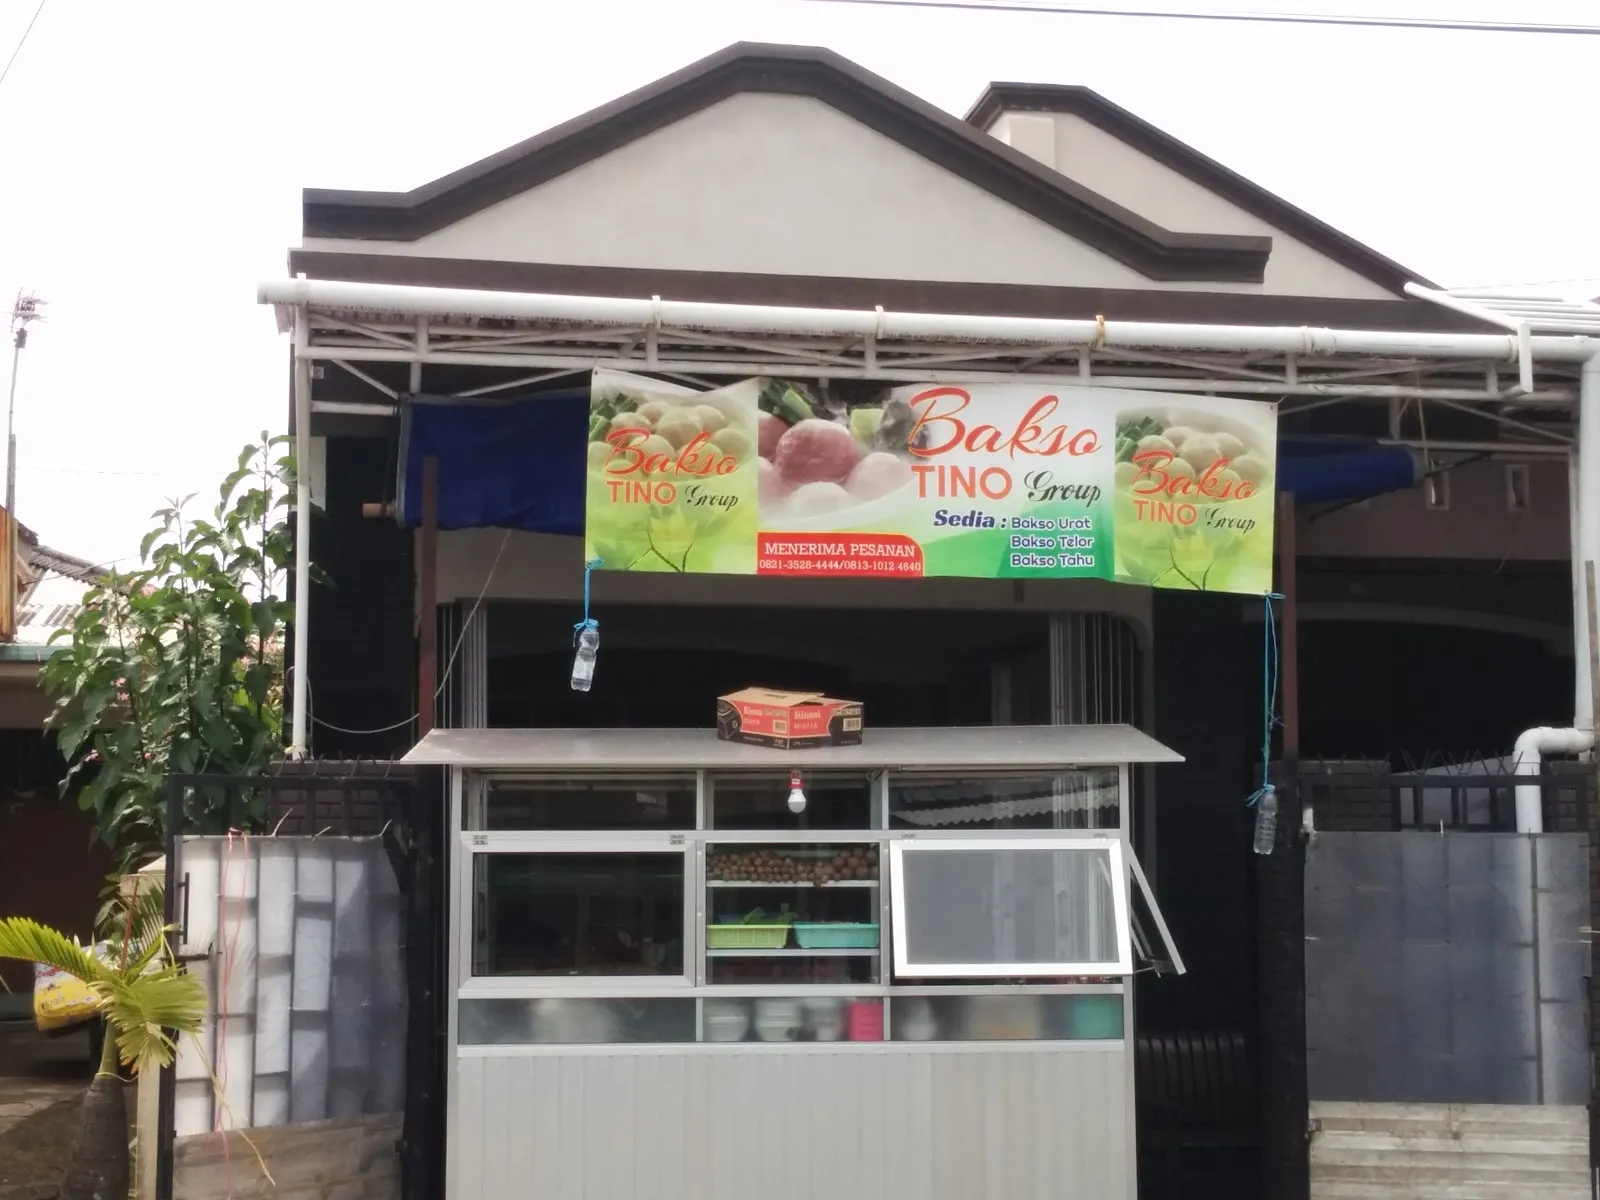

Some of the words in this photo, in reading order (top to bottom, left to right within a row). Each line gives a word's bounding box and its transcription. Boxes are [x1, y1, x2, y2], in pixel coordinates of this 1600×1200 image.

[908, 387, 1104, 461] Bakso
[605, 427, 740, 477] Bakso
[911, 465, 1013, 500] TINO
[1024, 470, 1101, 508] Group
[1132, 450, 1258, 499] Bakso
[606, 481, 677, 505] TINO
[684, 484, 739, 512] Group
[933, 509, 995, 528] Sedia
[1011, 516, 1055, 530] Bakso
[1058, 518, 1091, 530] Urat
[1134, 500, 1198, 526] TINO
[1204, 507, 1256, 534] Group
[764, 542, 847, 556] MENERIMA
[849, 544, 916, 558] PESANAN
[1011, 535, 1055, 549] Bakso
[1059, 536, 1094, 548] Telor
[1011, 553, 1055, 567] Bakso
[1059, 554, 1094, 567] Tahu
